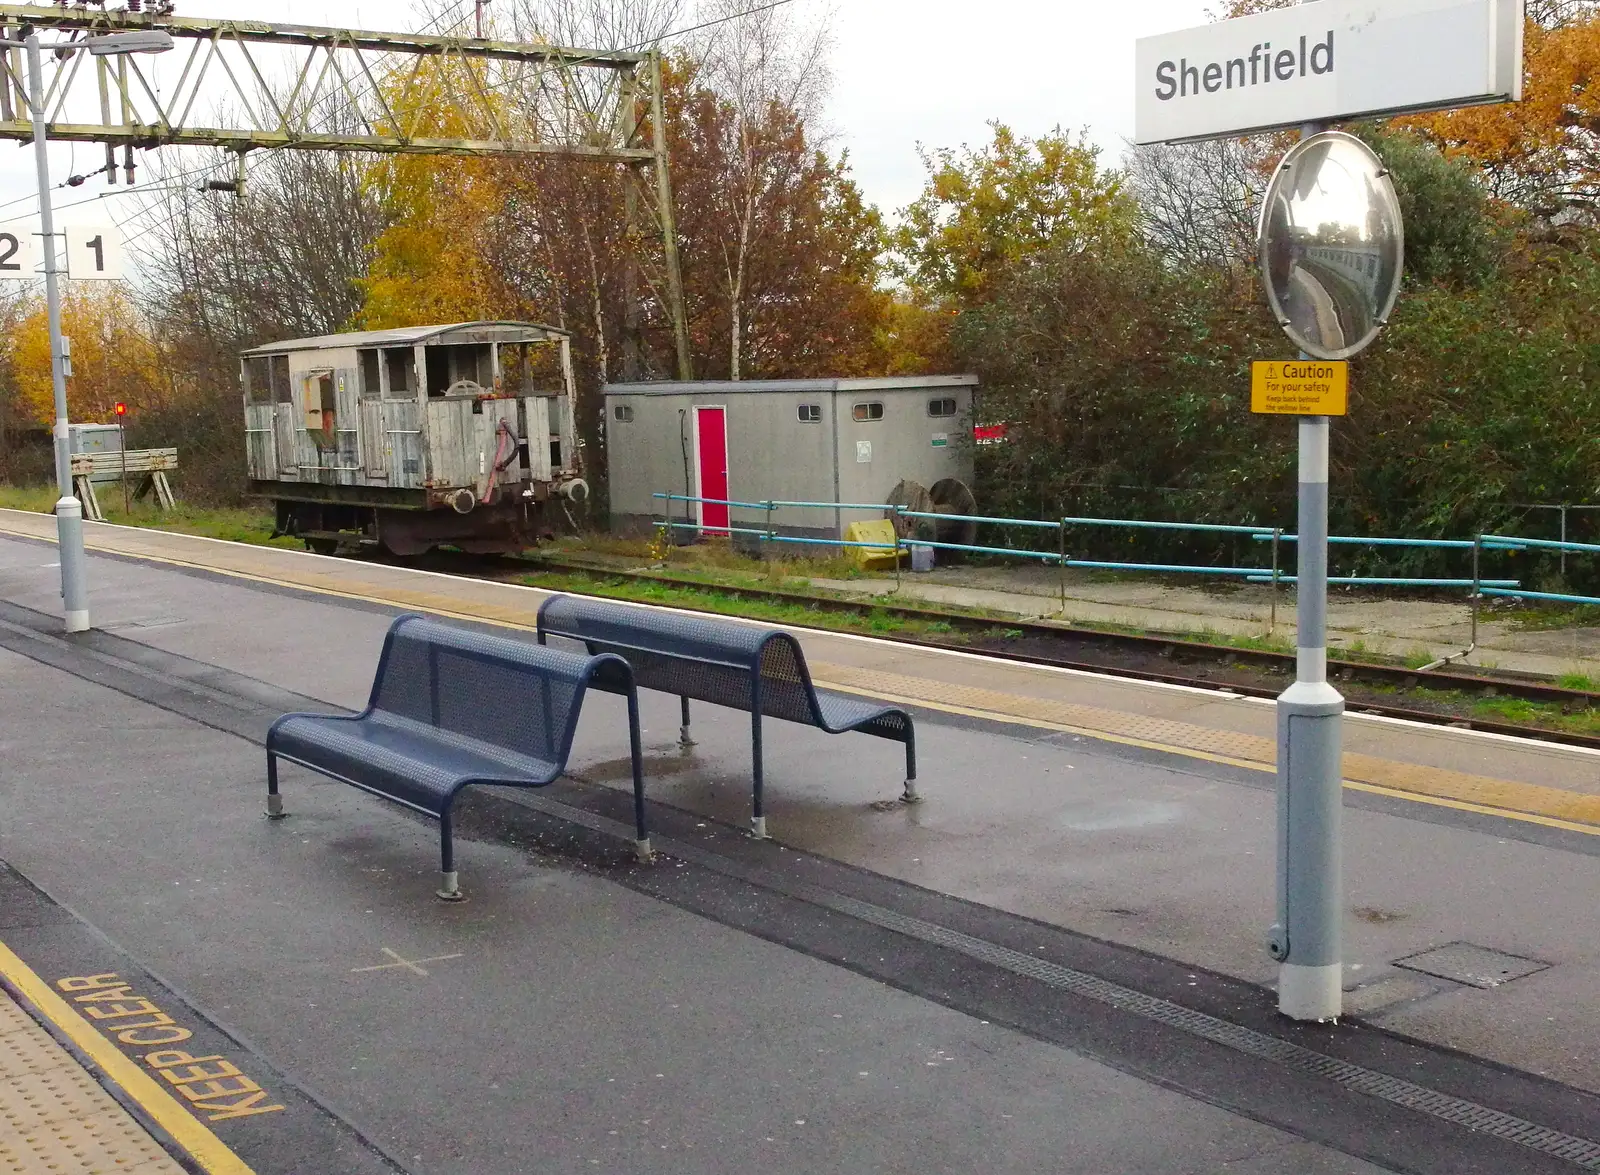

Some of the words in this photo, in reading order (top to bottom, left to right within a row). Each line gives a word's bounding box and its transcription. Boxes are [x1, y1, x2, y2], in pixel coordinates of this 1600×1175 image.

[1155, 30, 1334, 101] Shenfield
[0, 232, 20, 270] 2
[86, 235, 104, 271] 1
[1266, 381, 1280, 391] For
[1282, 384, 1301, 393] your
[1303, 381, 1330, 394] safety
[1282, 364, 1333, 379] Caution
[57, 973, 193, 1045] CLEAR
[145, 1050, 285, 1121] KEEP
